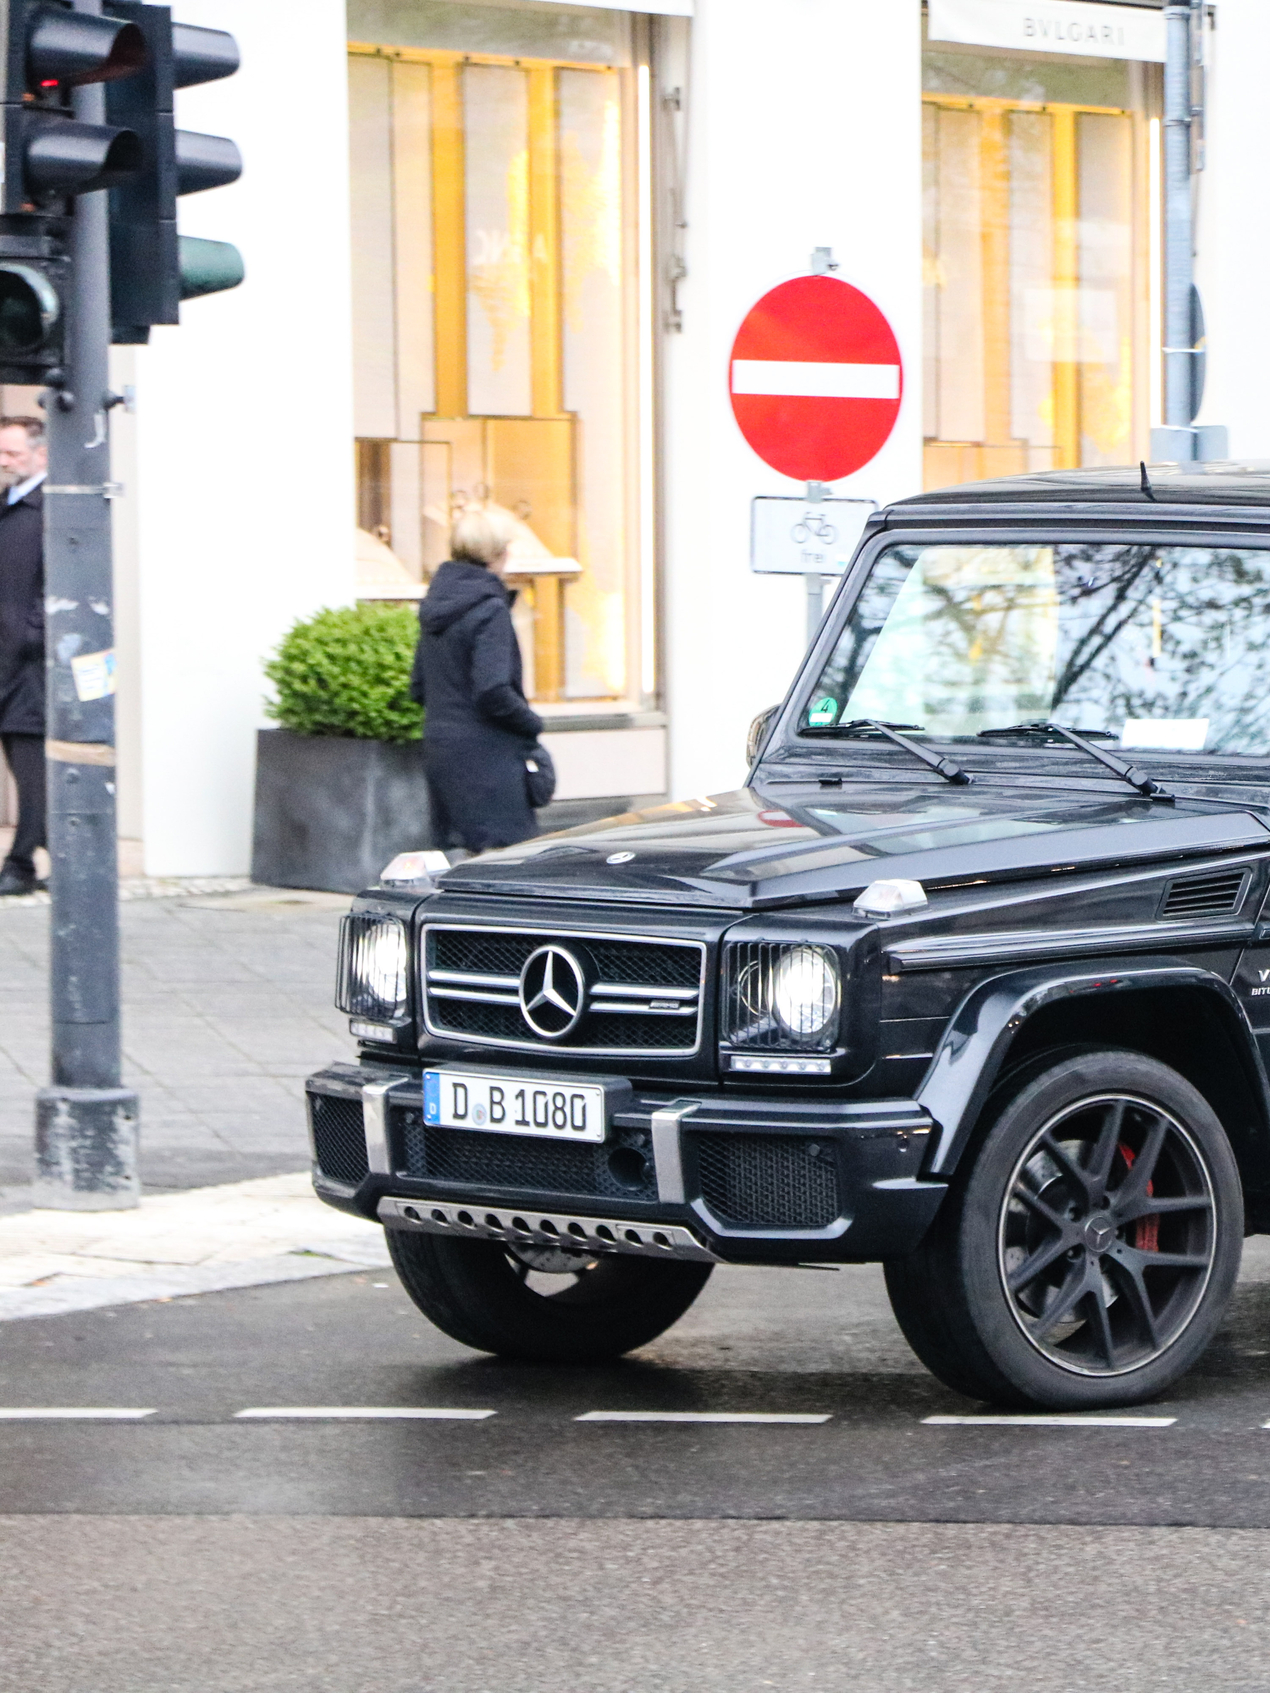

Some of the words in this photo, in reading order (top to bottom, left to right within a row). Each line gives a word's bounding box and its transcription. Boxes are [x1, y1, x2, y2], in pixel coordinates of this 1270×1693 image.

[1023, 18, 1125, 46] BVLGARI
[820, 698, 830, 713] 4
[452, 1082, 468, 1120] D
[489, 1086, 506, 1123] B
[515, 1089, 587, 1132] 1080
